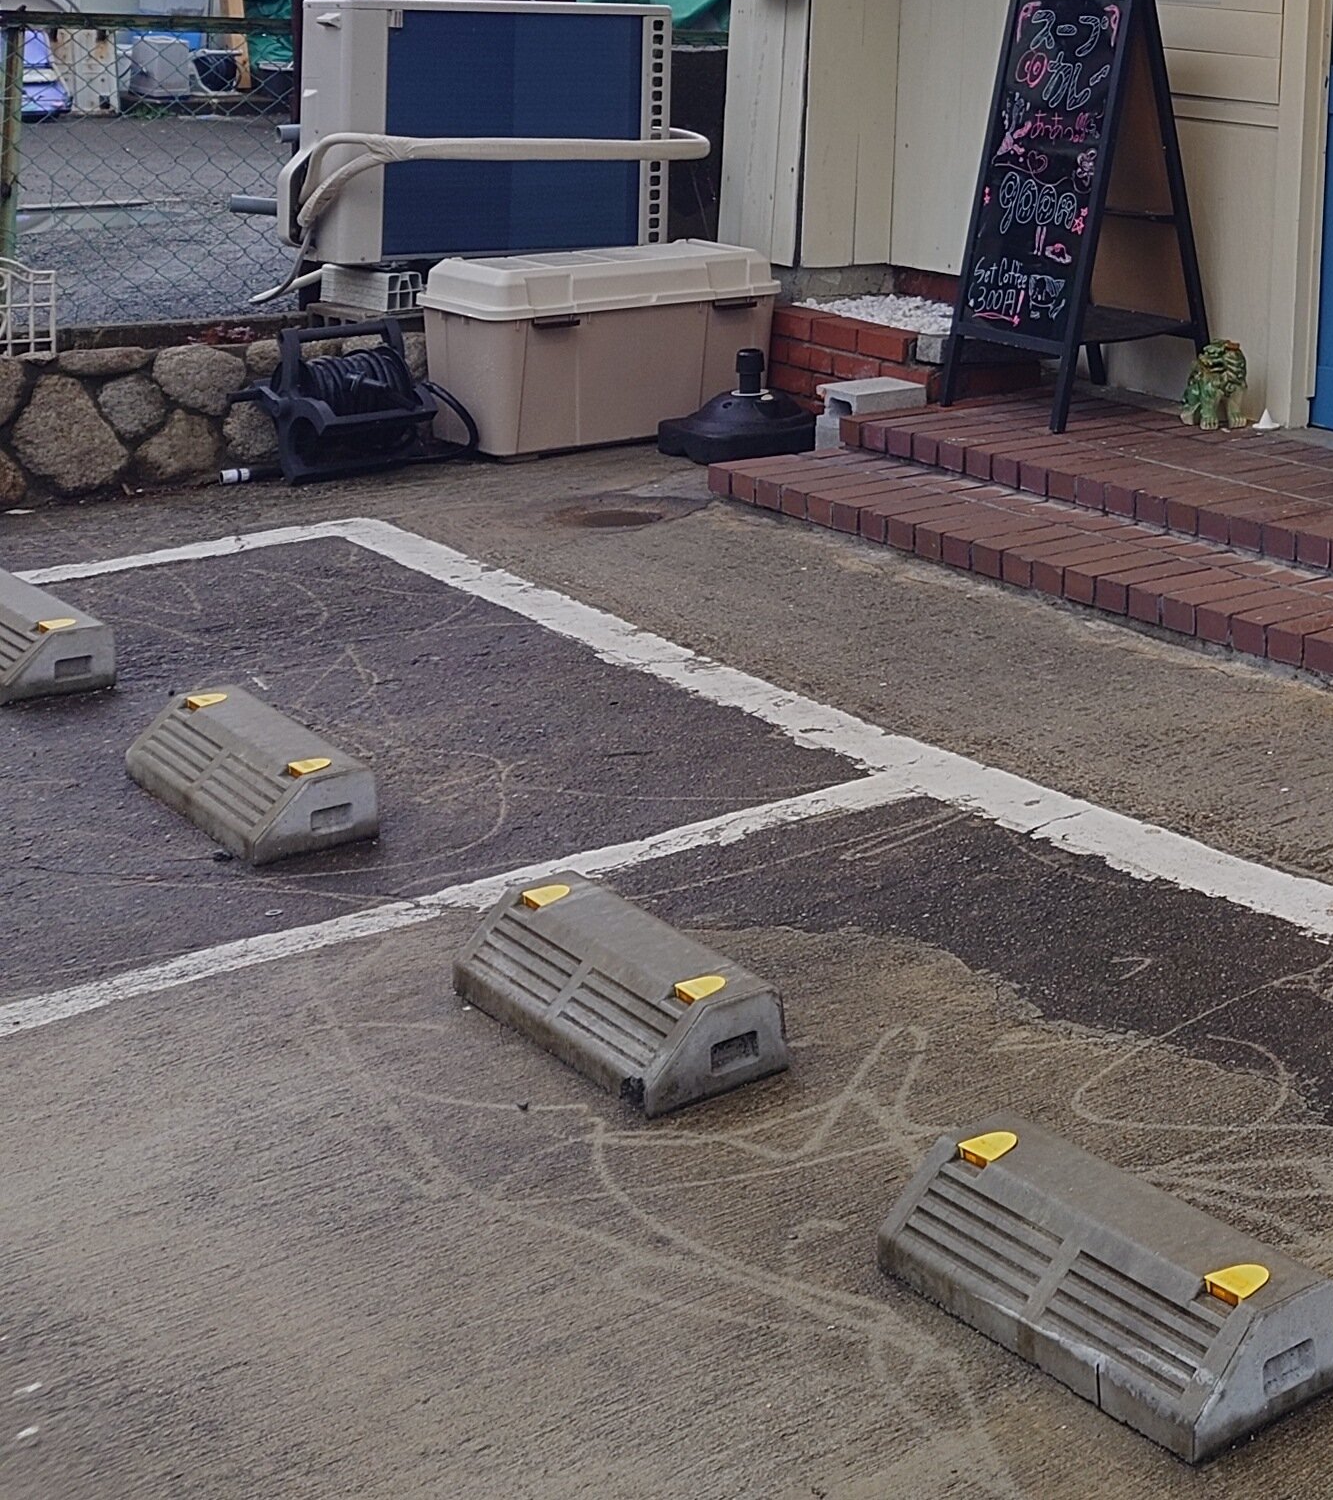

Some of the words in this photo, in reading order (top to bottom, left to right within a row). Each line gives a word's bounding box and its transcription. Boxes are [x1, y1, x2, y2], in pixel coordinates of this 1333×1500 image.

[1030, 9, 1109, 57] スープ
[1042, 51, 1110, 111] カレー
[1000, 171, 1077, 235] 900円
[973, 256, 998, 284] Set
[999, 257, 1028, 289] Coffee
